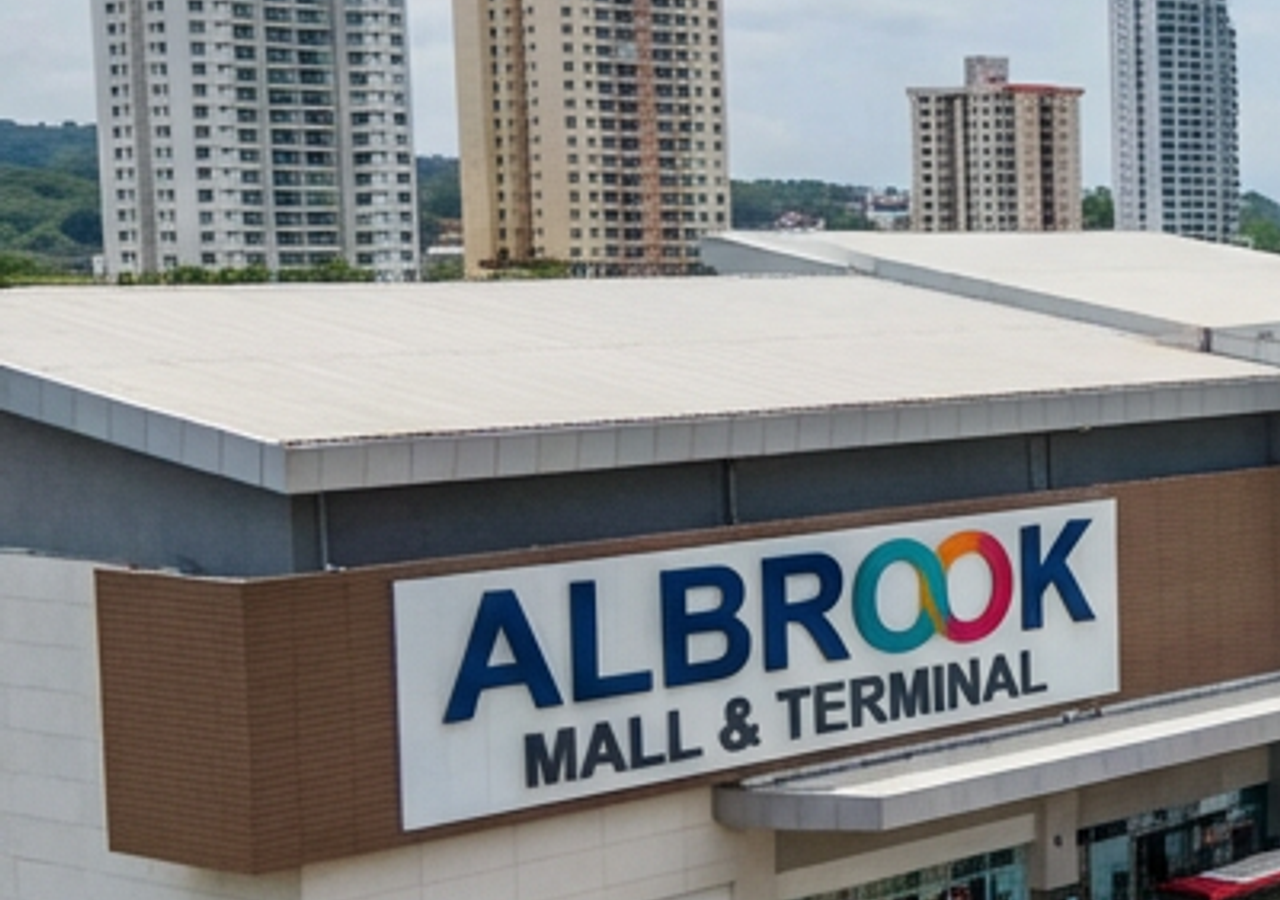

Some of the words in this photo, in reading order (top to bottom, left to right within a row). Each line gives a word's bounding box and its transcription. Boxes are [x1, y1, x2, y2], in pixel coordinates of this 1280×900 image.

[443, 519, 1095, 724] ALBROOK
[524, 710, 703, 788] MALL
[719, 697, 760, 752] &
[777, 650, 1048, 741] TERMINAL
